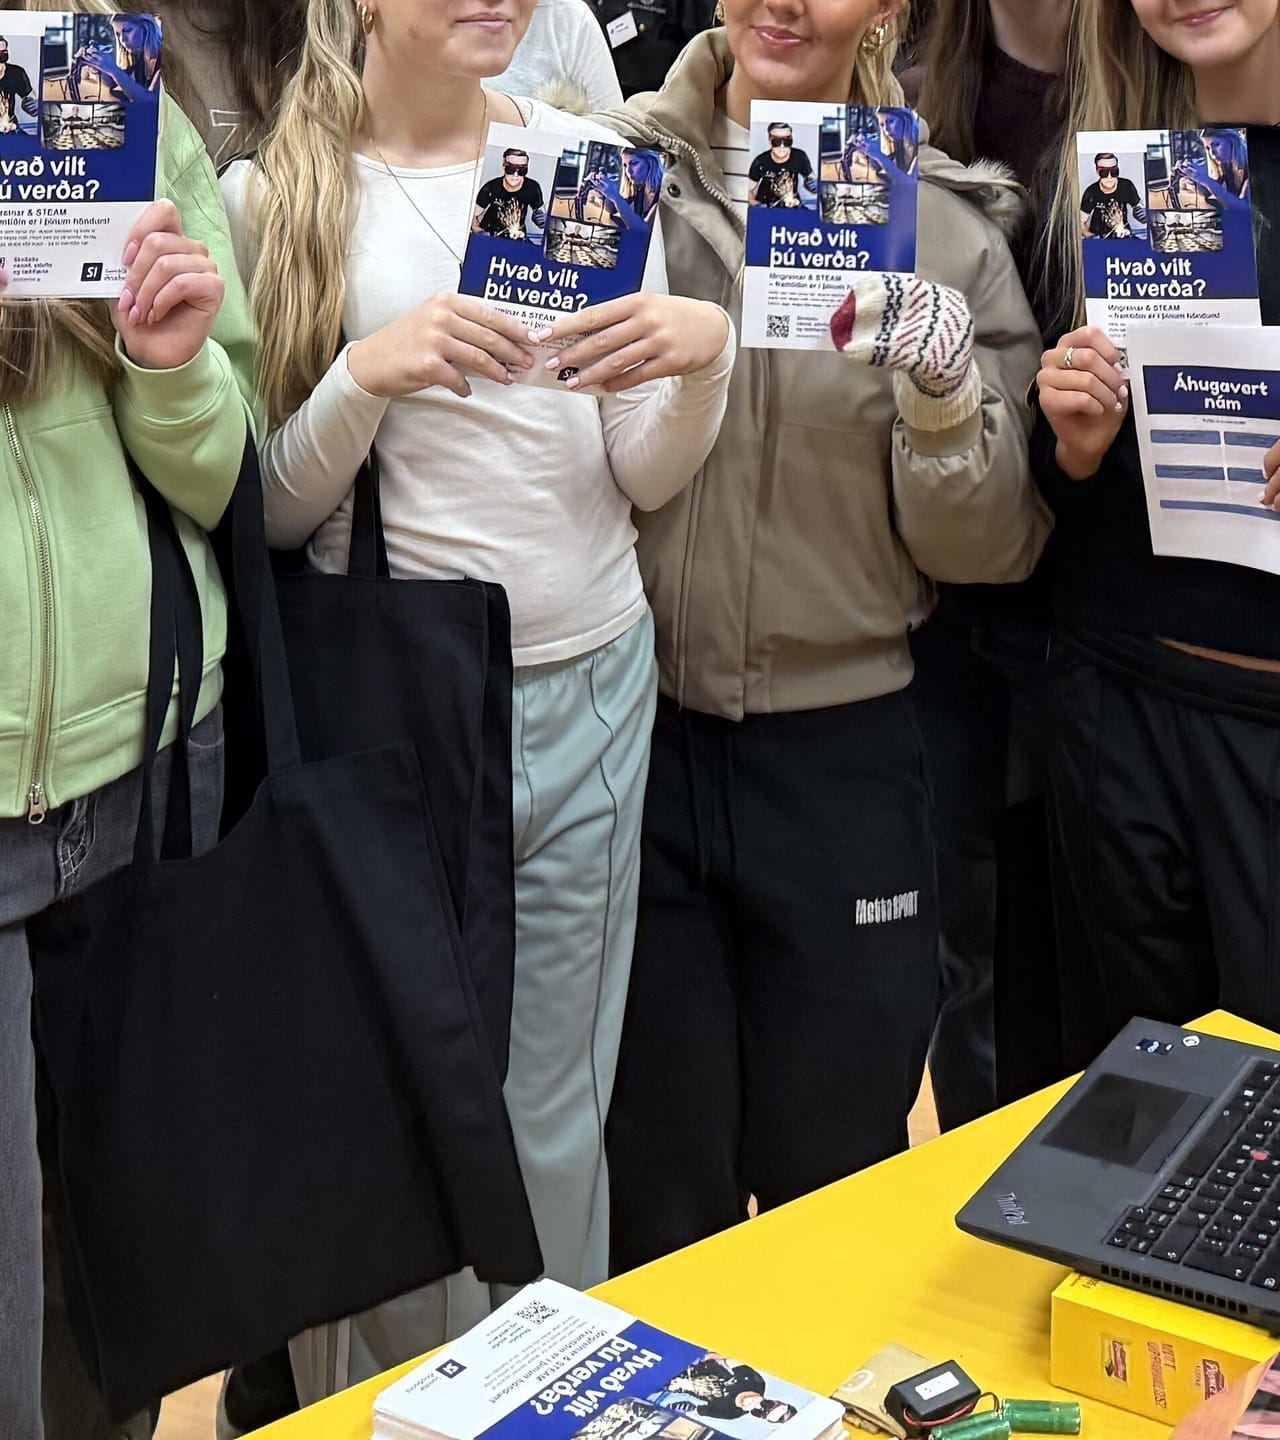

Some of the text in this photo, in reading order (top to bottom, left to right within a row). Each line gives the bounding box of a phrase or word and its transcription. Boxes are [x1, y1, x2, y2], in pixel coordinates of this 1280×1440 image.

[50, 156, 86, 176] vilt
[18, 179, 100, 200] verða?
[35, 208, 67, 216] STEAM
[771, 226, 858, 248] Hvað vilt
[770, 247, 870, 269] þú verða?
[1106, 257, 1192, 276] Hvað vilt
[86, 266, 98, 278] SI
[489, 256, 580, 289] Hvað vilt
[484, 278, 589, 313] þú verða?
[1107, 278, 1206, 300] þú verða?
[1204, 394, 1241, 411] nám
[601, 1336, 638, 1363] þú
[598, 1349, 664, 1393] Hvað
[530, 1356, 606, 1415] verða?
[563, 1389, 607, 1417] vilt
